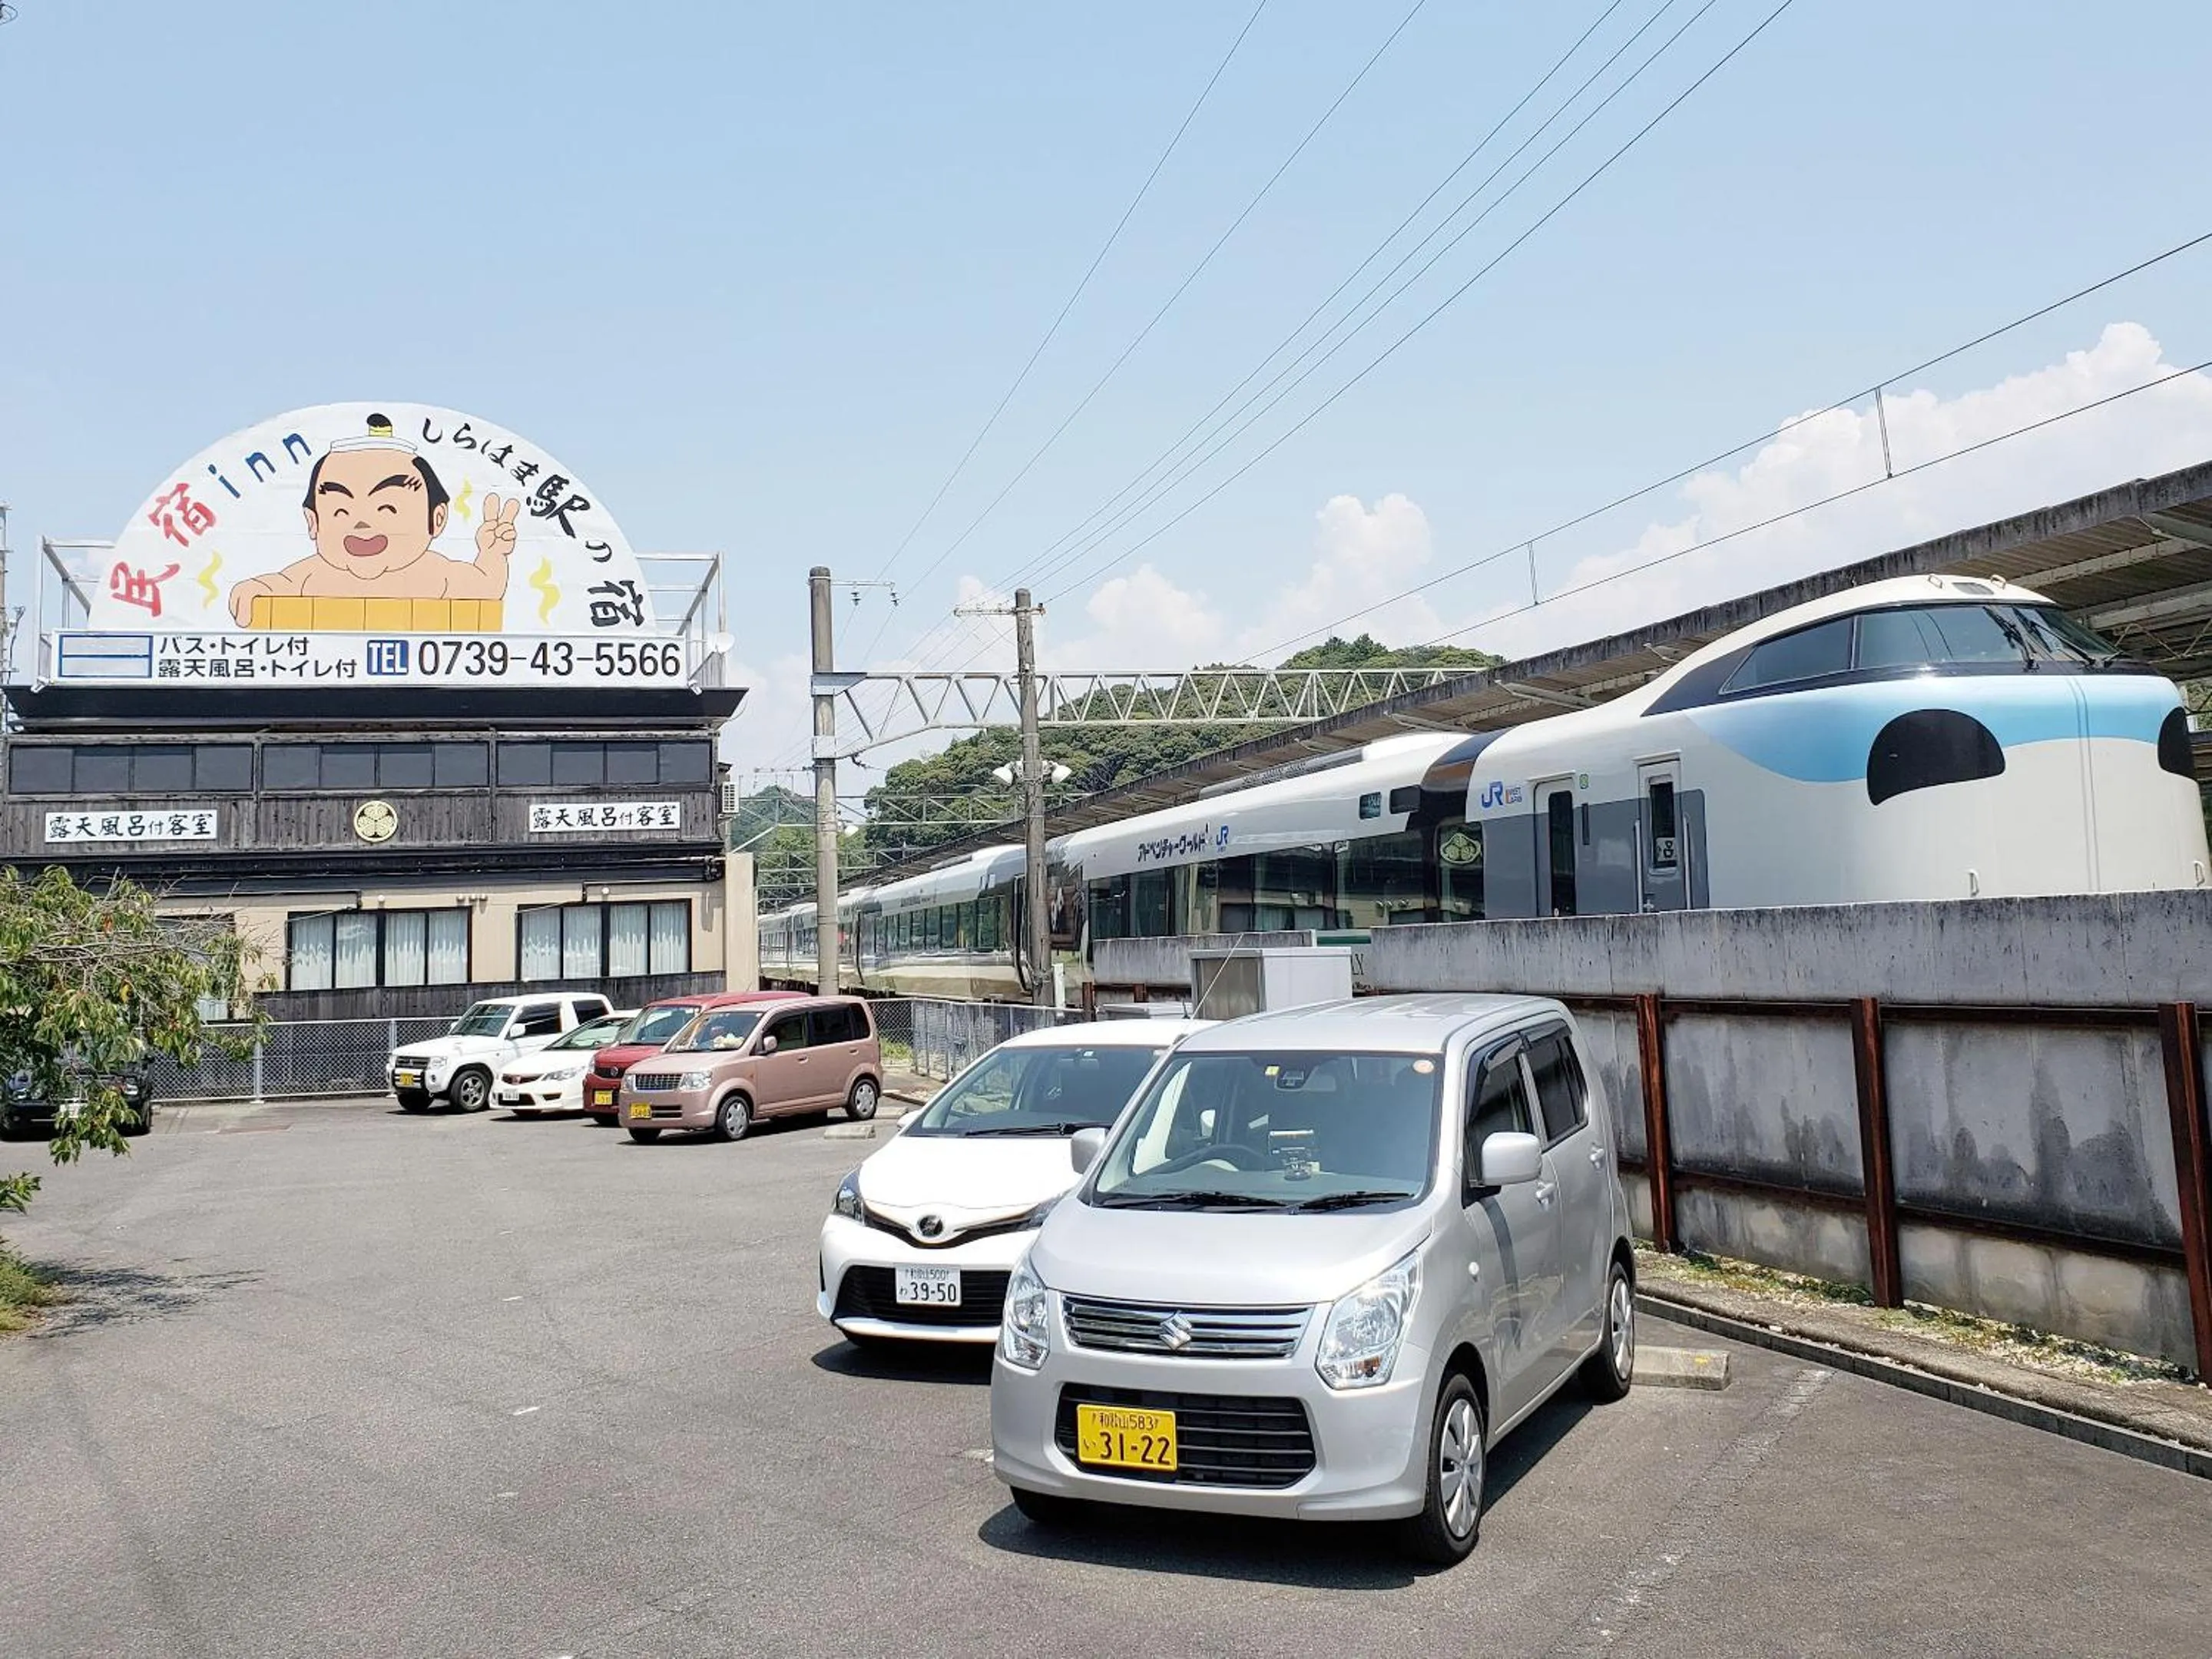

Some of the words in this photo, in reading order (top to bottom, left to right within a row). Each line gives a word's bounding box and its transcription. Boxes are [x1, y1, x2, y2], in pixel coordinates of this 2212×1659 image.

[110, 483, 217, 618] 民宿
[207, 432, 312, 499] inn
[160, 636, 310, 656] バス・トイレ付
[158, 658, 358, 679] 露天風呂・トイレ付
[369, 642, 408, 674] TEL
[419, 641, 681, 677] 0739-43-5566
[1481, 780, 1504, 808] JR
[49, 813, 213, 838] 露天風呂付客室
[534, 805, 676, 829] 露天風呂付客室
[1216, 825, 1229, 846] JR
[909, 1282, 956, 1302] 39-50
[1100, 1431, 1171, 1465] 31-22
